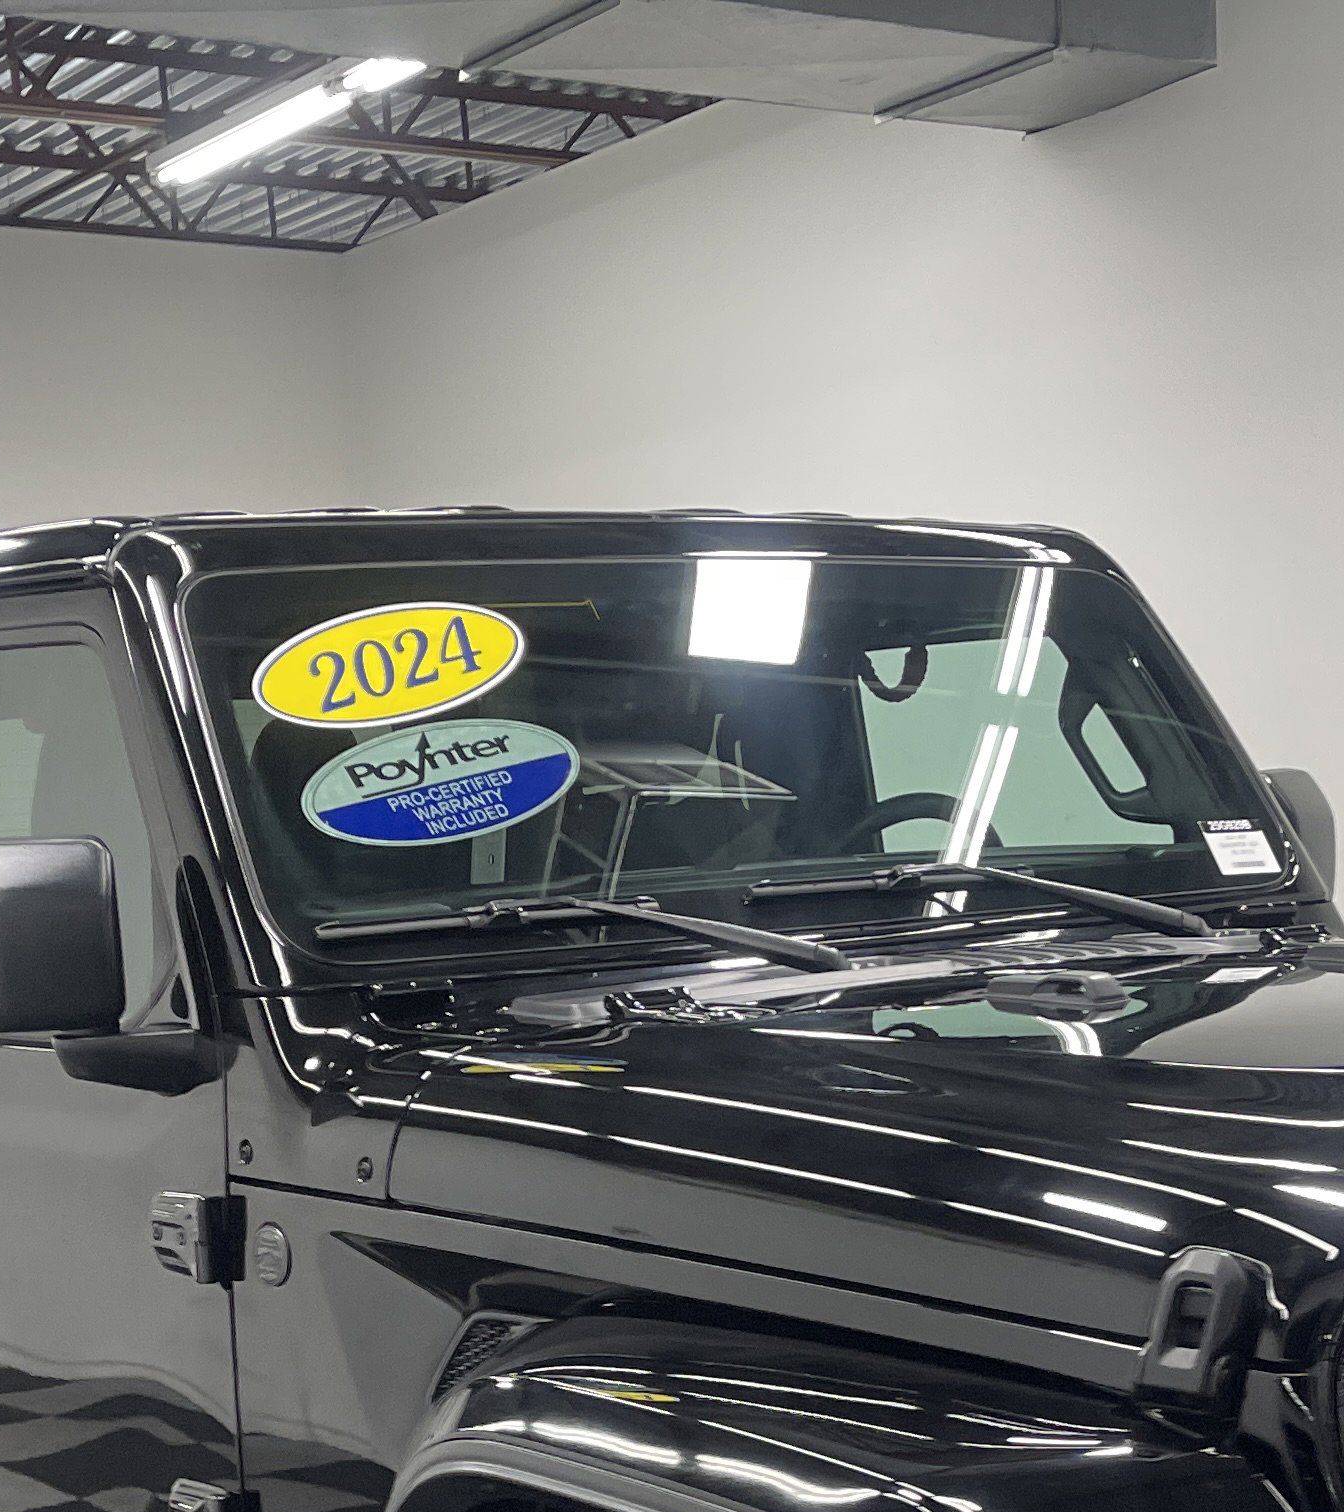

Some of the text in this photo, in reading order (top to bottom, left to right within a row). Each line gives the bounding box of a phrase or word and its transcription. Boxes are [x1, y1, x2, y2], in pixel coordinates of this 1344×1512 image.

[309, 616, 482, 713] 2024
[344, 731, 511, 798] Poynter
[388, 770, 513, 813] PRO-CERTIFIED
[412, 787, 505, 824] WARRANTY
[428, 802, 509, 836] INCLUDED
